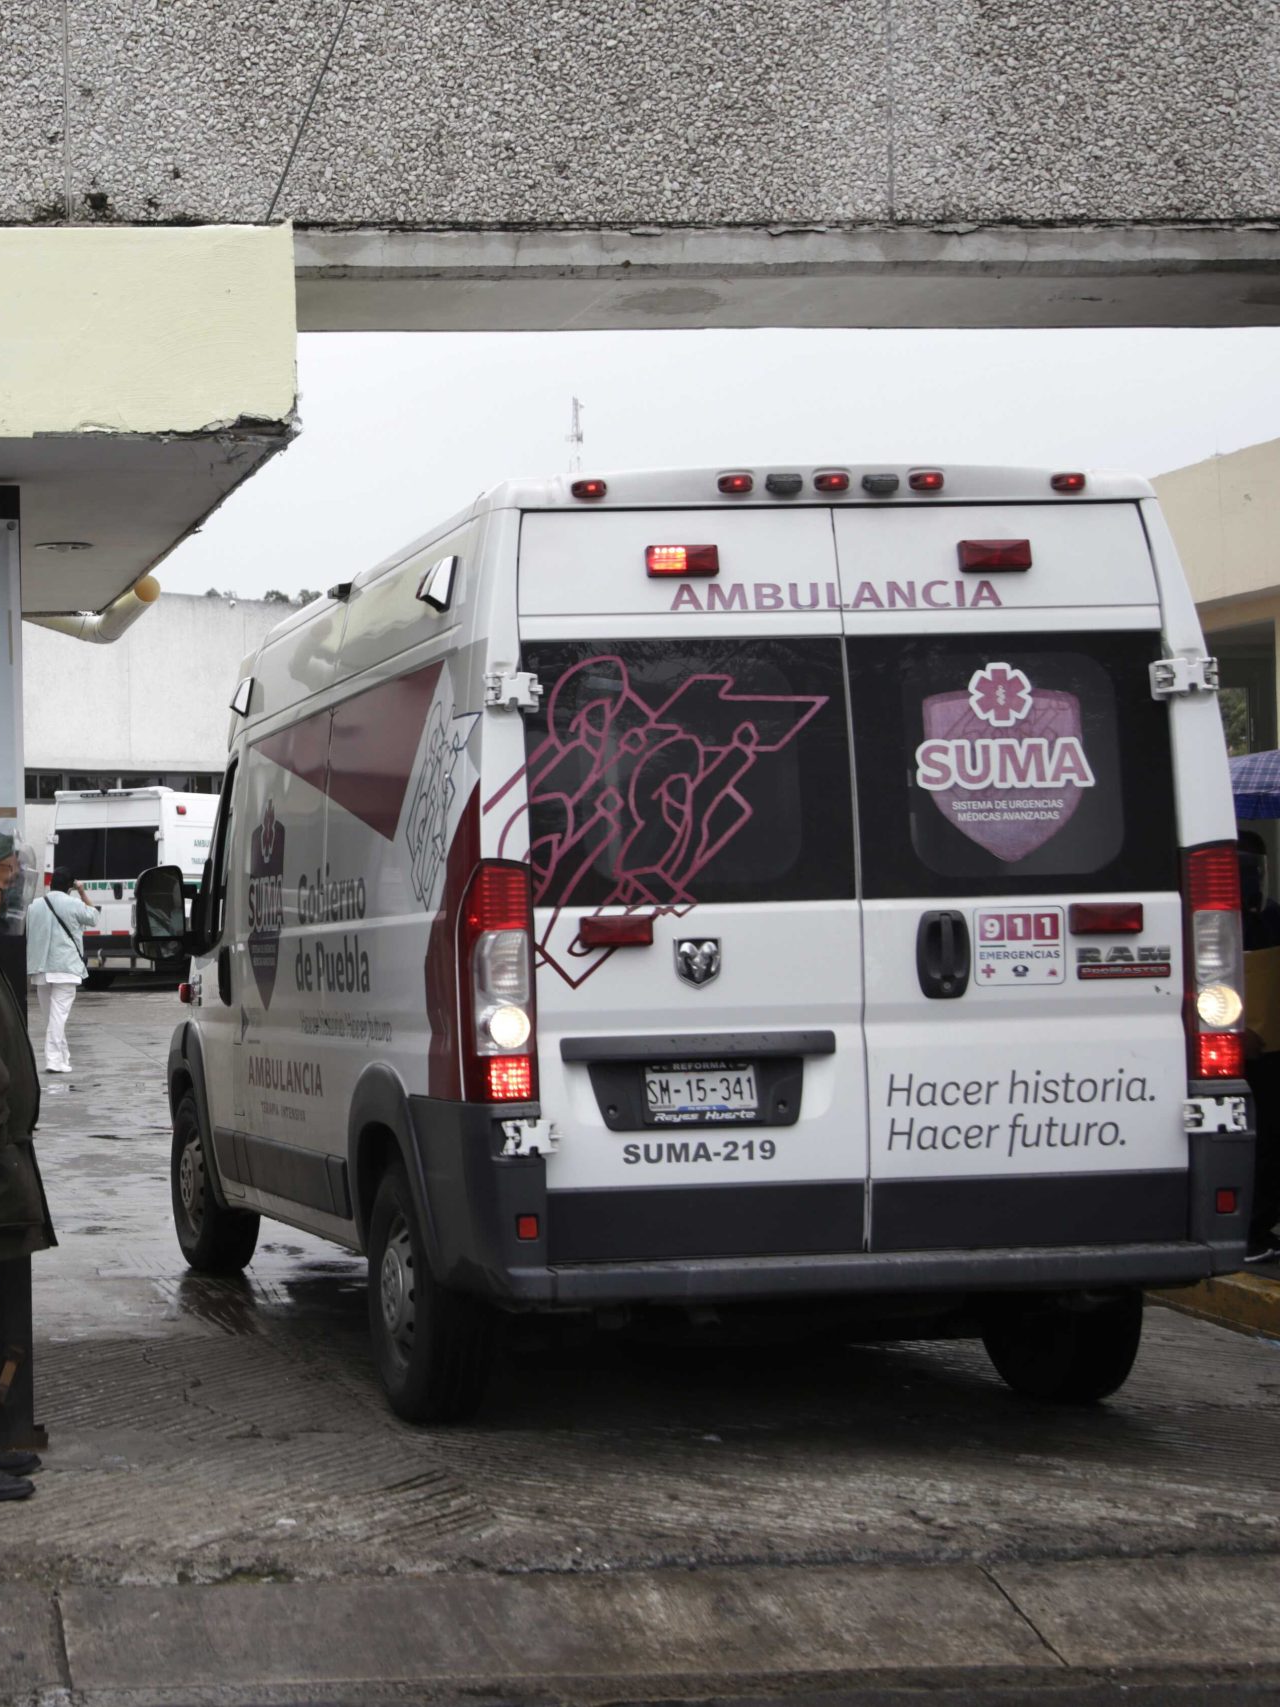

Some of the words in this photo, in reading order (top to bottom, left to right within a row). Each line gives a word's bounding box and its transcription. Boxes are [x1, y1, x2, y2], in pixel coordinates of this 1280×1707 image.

[669, 579, 1002, 612] AMBULANCIA
[915, 737, 1096, 791] SUMA
[952, 800, 994, 810] SISTEMA
[995, 800, 1008, 809] DE
[1009, 799, 1064, 809] URGENCIAS
[957, 810, 1001, 822] MÉDICAS
[1002, 811, 1060, 821] AVANZADAS
[248, 876, 284, 931] SUMA
[298, 862, 366, 925] Gobierno
[980, 914, 1058, 940] 911
[295, 937, 313, 992] de
[316, 934, 370, 993] Puebla
[979, 950, 1060, 960] EMERGENCIAS
[1076, 946, 1171, 963] RAM
[248, 1055, 323, 1097] AMBULANCIA
[672, 1062, 727, 1071] REFORMA
[647, 1077, 754, 1105] SM-15-341
[887, 1072, 1001, 1107] Hacer
[1008, 1067, 1157, 1105] historia.
[654, 1112, 699, 1122] Reyes
[887, 1115, 1001, 1151] Hacer
[1007, 1112, 1127, 1157] futuro.
[624, 1139, 776, 1165] SUMA-219
